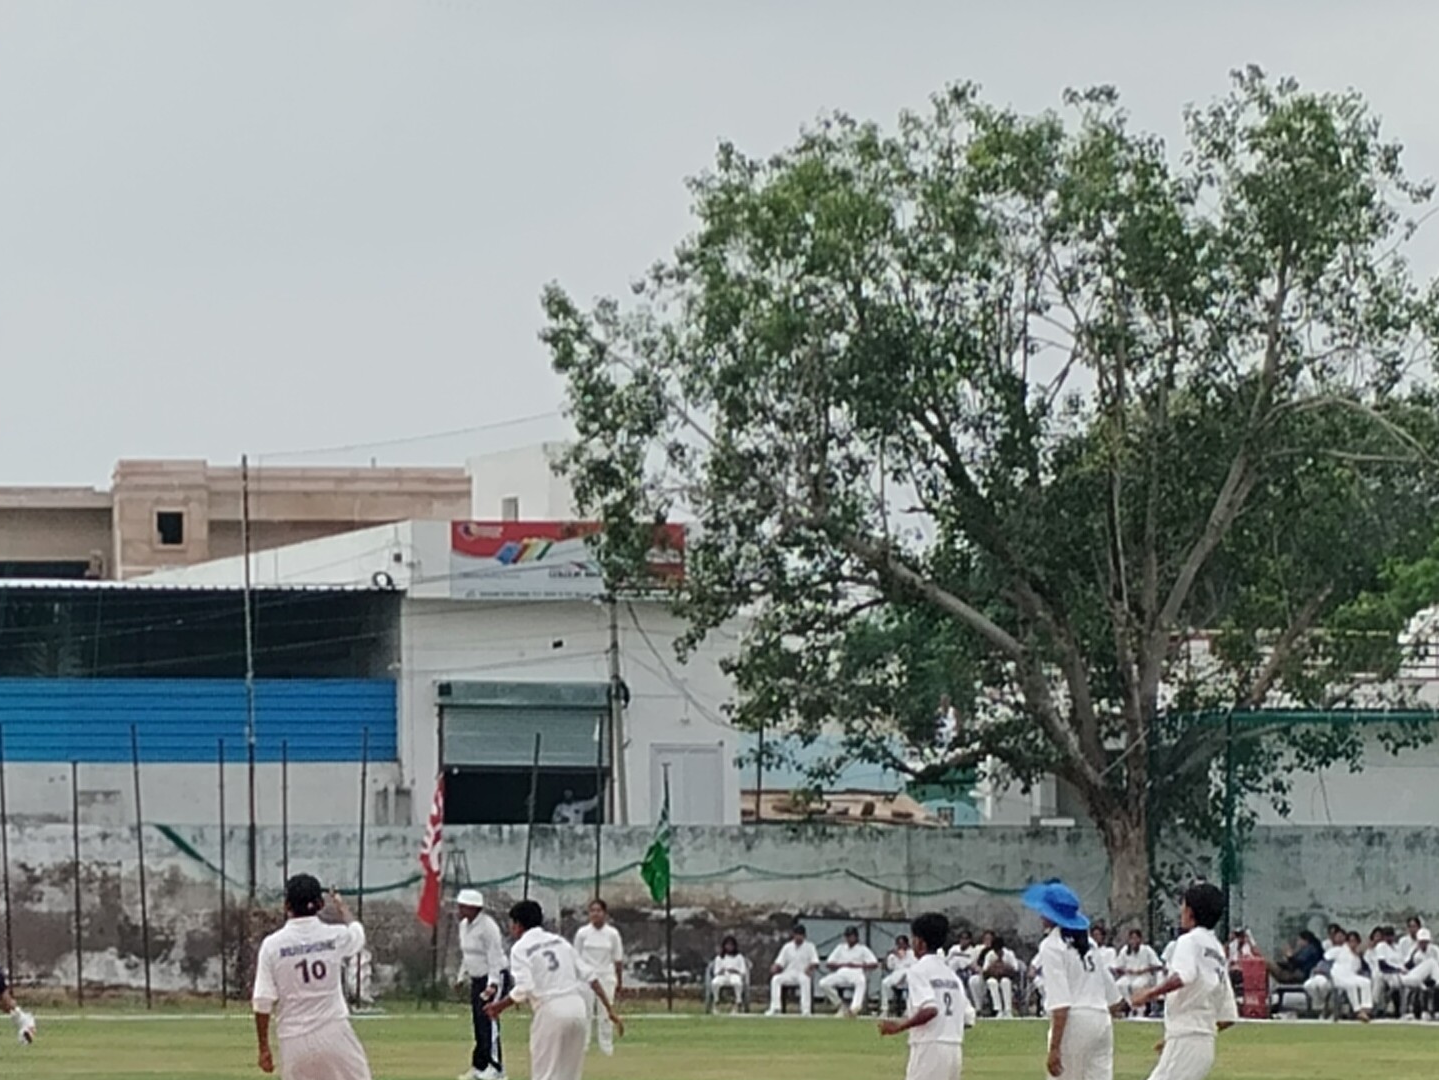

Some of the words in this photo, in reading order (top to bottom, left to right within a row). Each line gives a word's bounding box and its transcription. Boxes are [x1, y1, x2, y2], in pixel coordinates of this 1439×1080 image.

[294, 958, 327, 984] 10
[542, 950, 560, 972] 3
[943, 991, 953, 1016] 2
